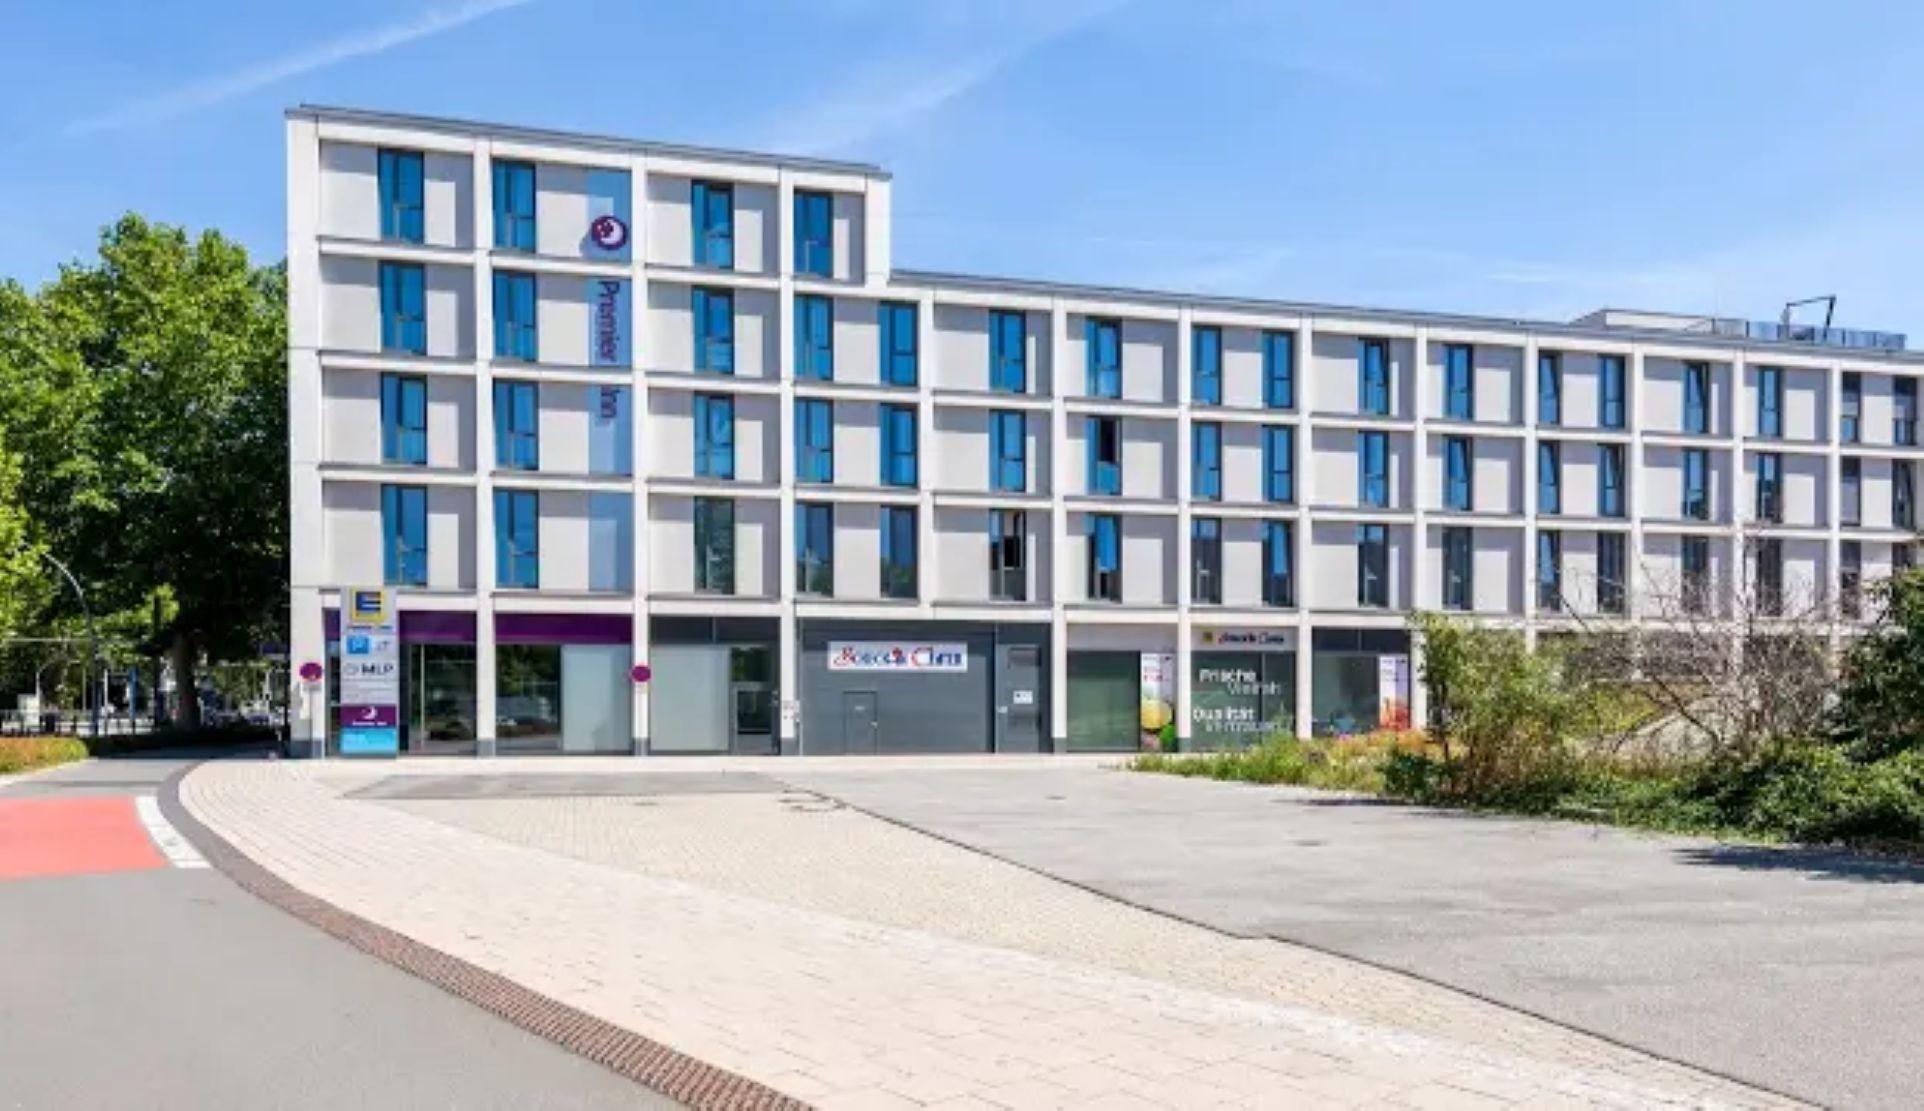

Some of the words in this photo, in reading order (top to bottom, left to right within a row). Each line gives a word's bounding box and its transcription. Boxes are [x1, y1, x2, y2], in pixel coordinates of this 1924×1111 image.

[598, 280, 620, 362] Premier
[600, 386, 620, 419] Inn
[355, 591, 381, 612] E
[362, 662, 394, 675] MLP
[1199, 668, 1257, 682] Frische
[1193, 705, 1255, 722] Qualität
